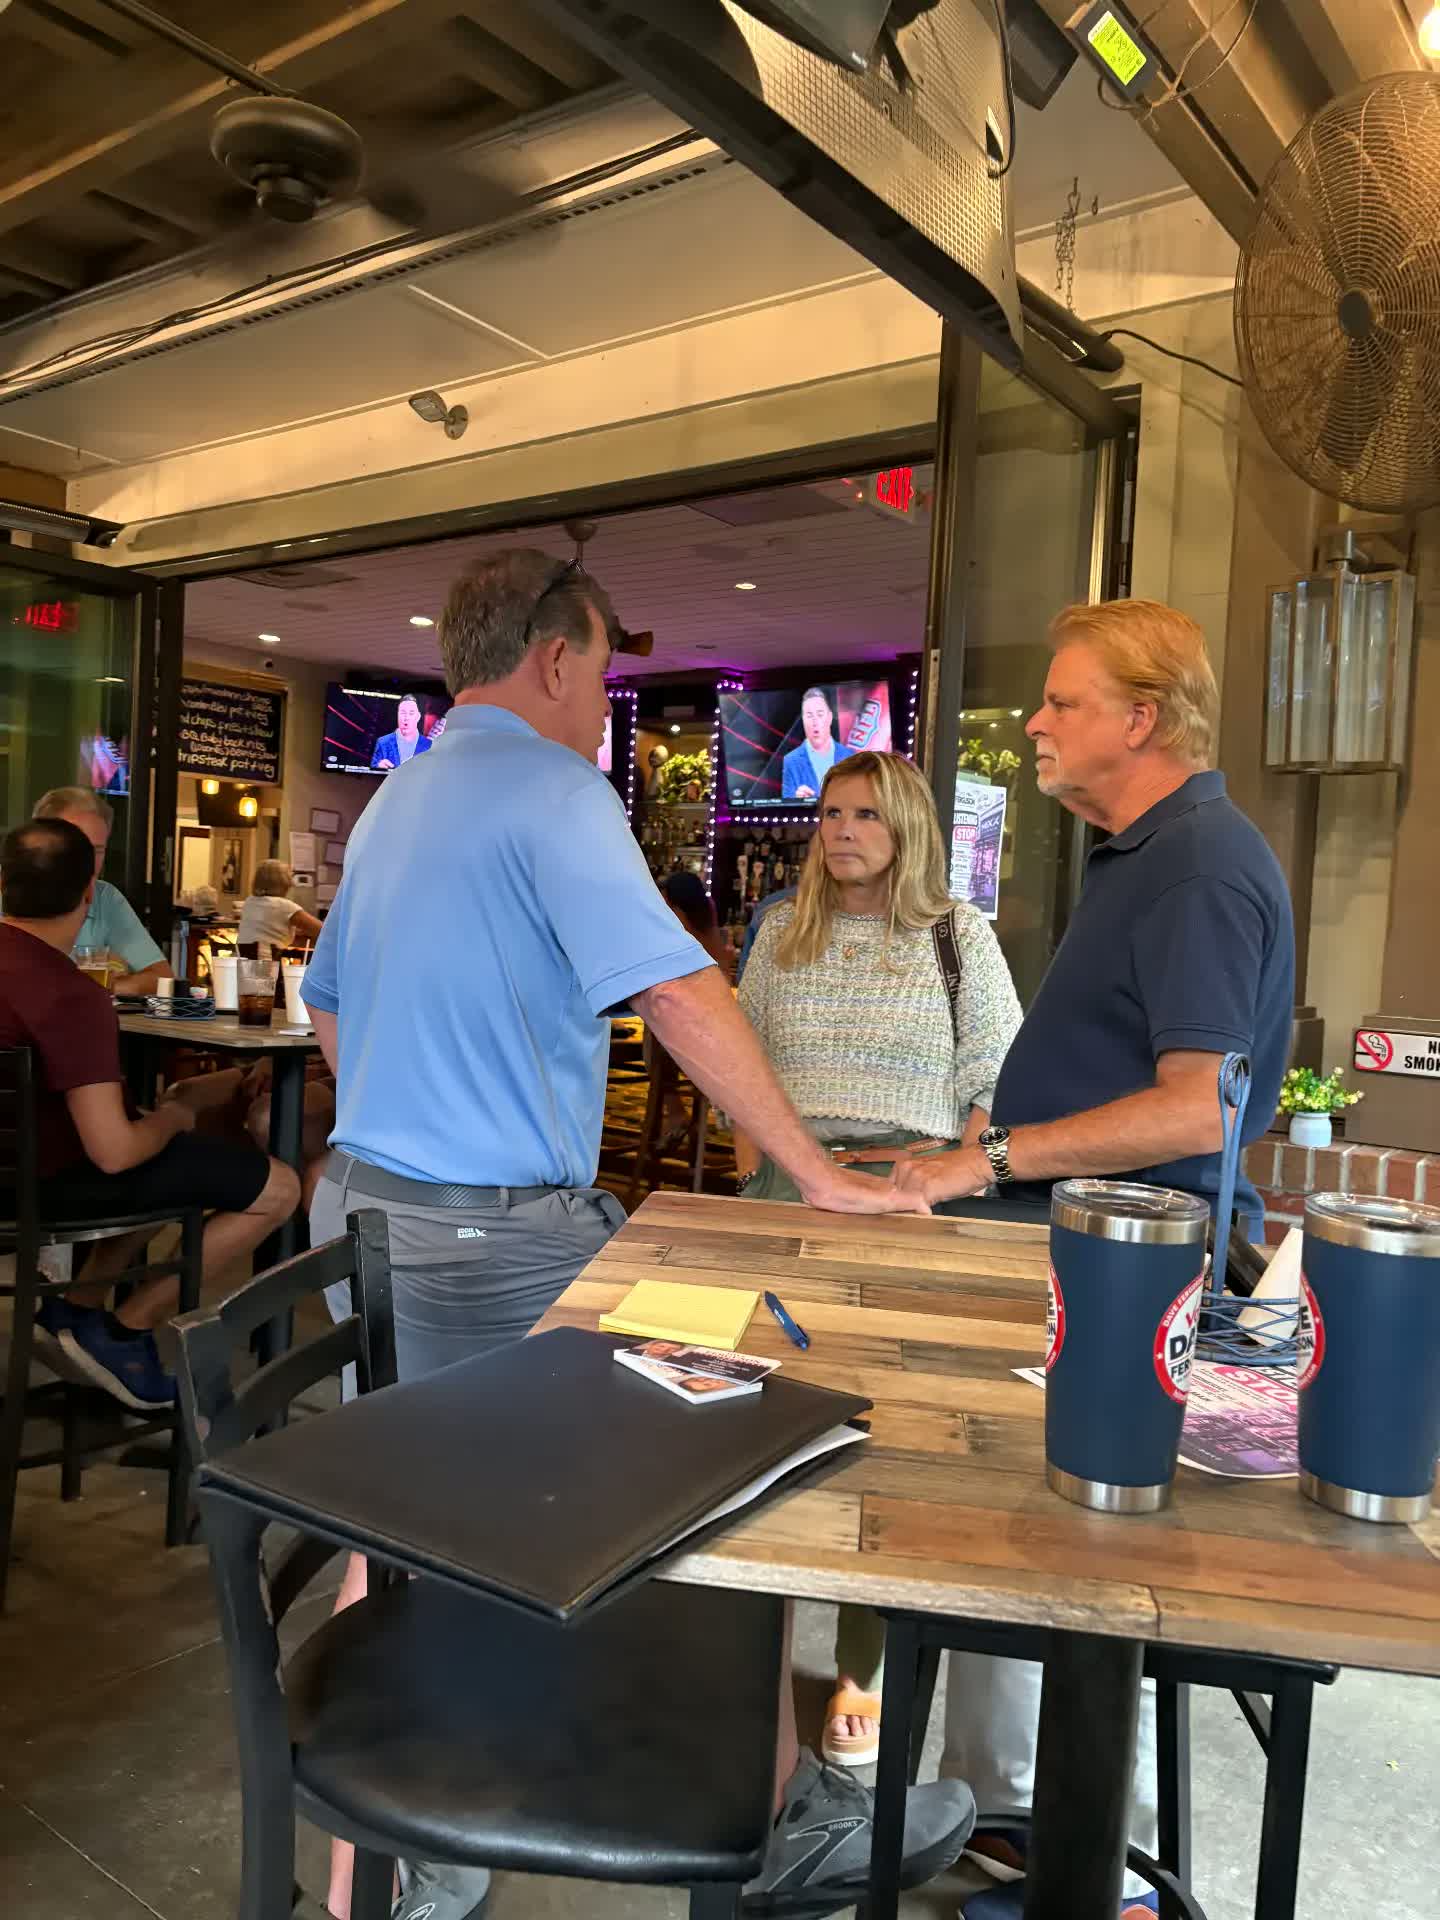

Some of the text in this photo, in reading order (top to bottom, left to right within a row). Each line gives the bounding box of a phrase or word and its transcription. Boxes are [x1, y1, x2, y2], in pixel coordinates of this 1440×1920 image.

[1161, 1302, 1180, 1328] DAVE
[1224, 1370, 1297, 1404] STO
[828, 1820, 858, 1832] BROOKS
